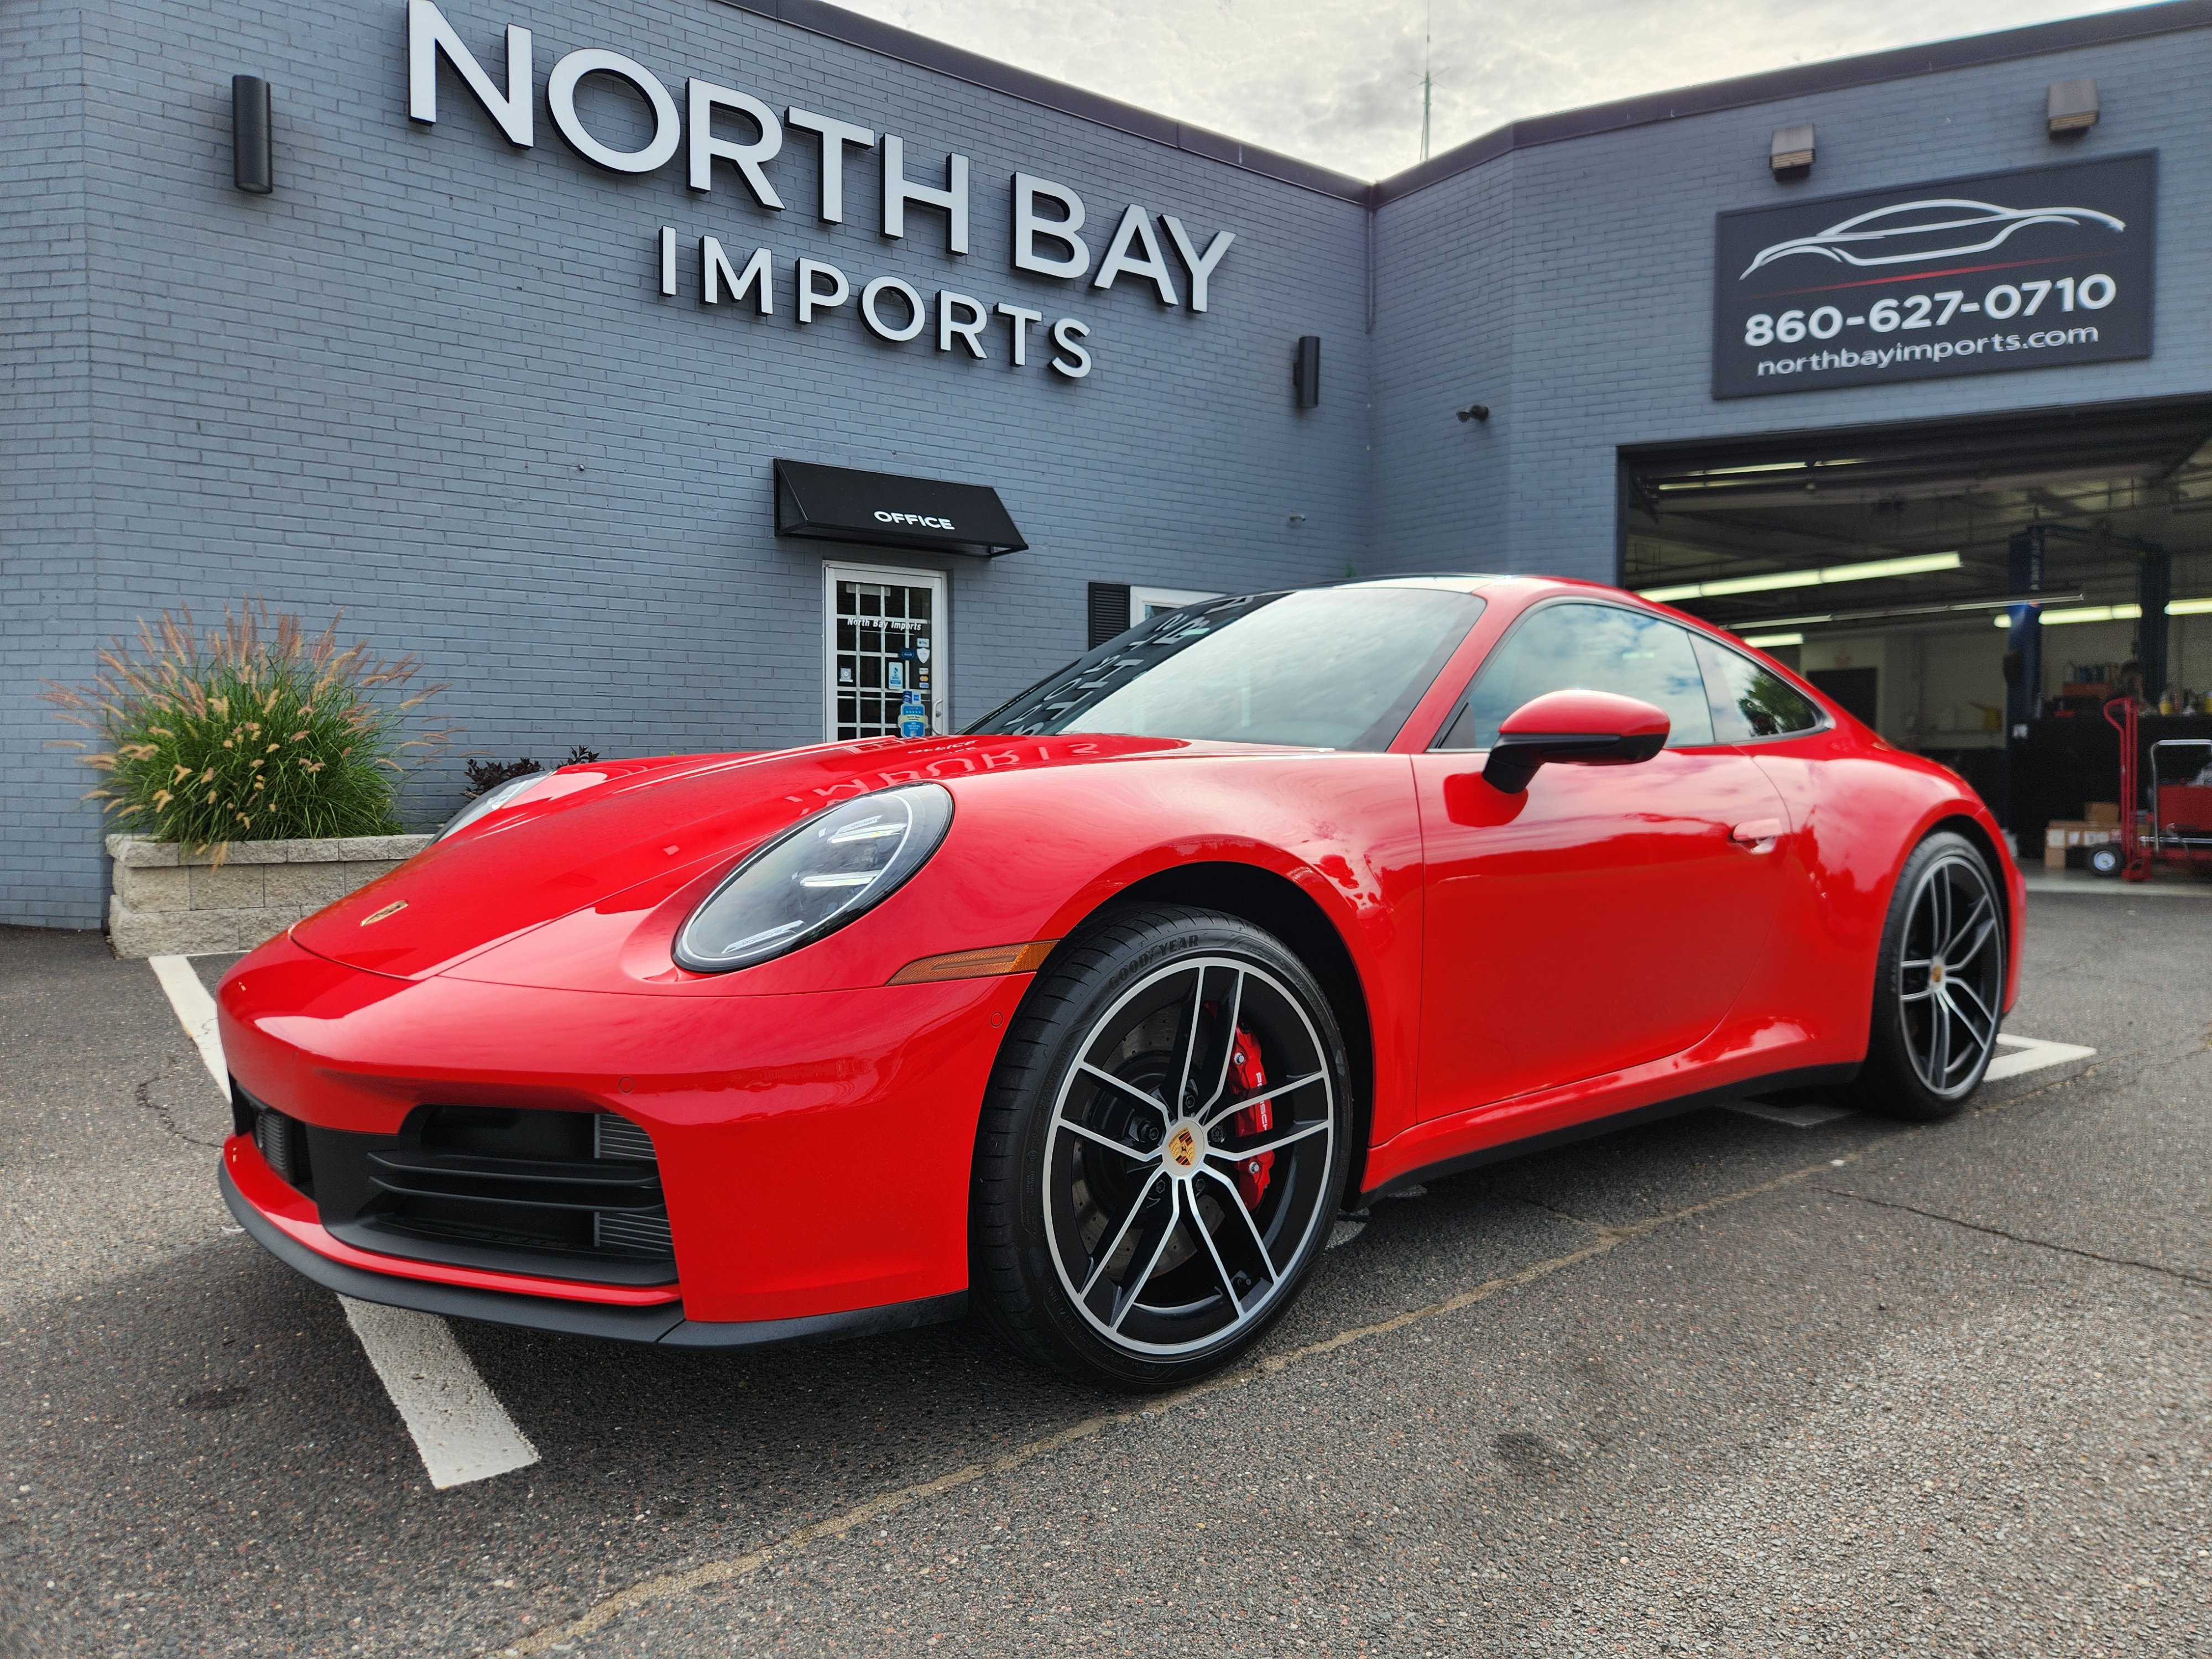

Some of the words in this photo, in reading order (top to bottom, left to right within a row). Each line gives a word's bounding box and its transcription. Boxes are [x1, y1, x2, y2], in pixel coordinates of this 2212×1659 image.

[408, 0, 969, 257] NORTH
[1010, 170, 1238, 314] BAY
[659, 225, 1093, 379] IMPORTS
[1744, 273, 2117, 347] 860-627-0710
[1757, 324, 2099, 377] northbayimports.com
[873, 510, 956, 530] OFFICE
[847, 617, 870, 627] North
[873, 619, 889, 629] Bay
[890, 620, 922, 631] Imports
[1108, 934, 1199, 990] GOODYEAR
